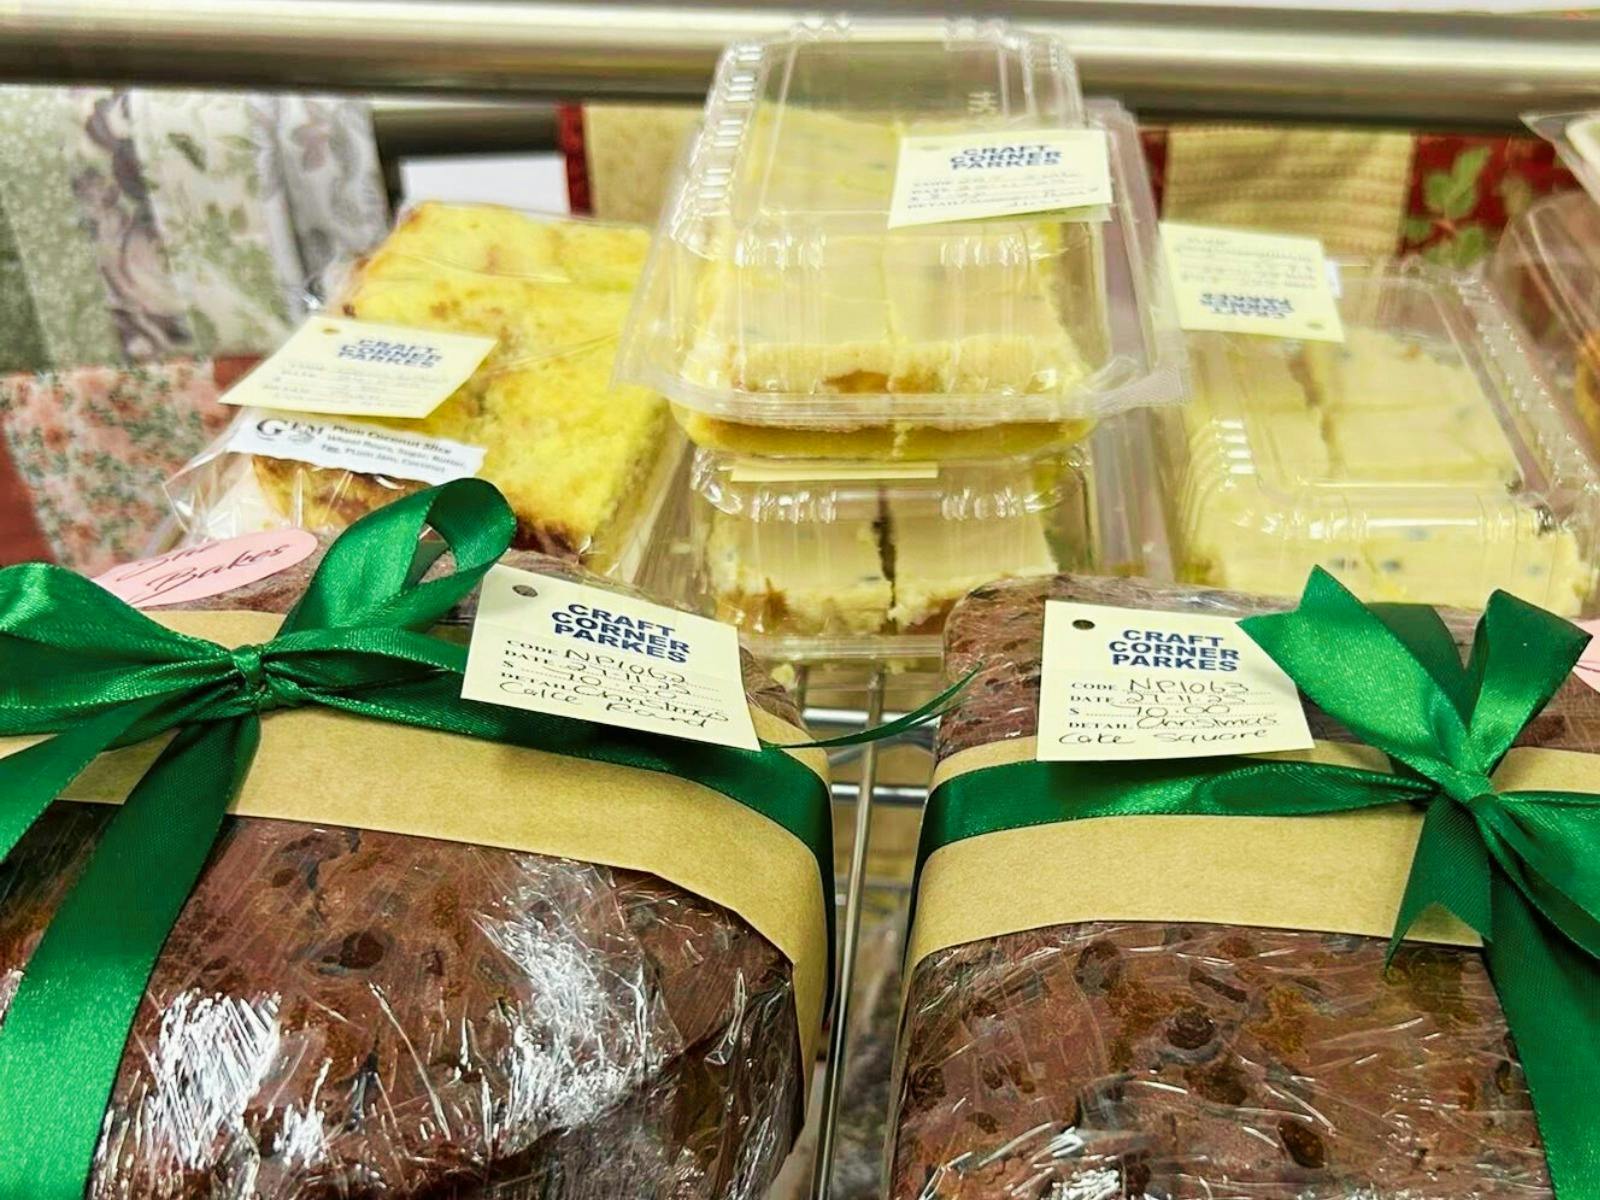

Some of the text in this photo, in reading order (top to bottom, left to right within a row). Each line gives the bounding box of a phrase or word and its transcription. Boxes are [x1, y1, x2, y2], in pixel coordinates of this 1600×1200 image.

[950, 151, 1062, 164] CORNER
[963, 143, 1051, 156] CRAFT
[952, 159, 1060, 170] PARKES
[341, 345, 443, 362] CORNER
[358, 338, 442, 353] CRAFT
[338, 351, 437, 368] PARKES
[568, 603, 676, 637] CRAFT
[551, 611, 691, 654] CORNER
[1122, 629, 1223, 648] CRAFT
[507, 639, 557, 656] CODE
[554, 623, 688, 664] PARKES
[1108, 641, 1240, 661] CORNER
[504, 649, 553, 665] DATE
[1112, 653, 1238, 672] PARKES
[1071, 682, 1118, 691] CODE
[1070, 695, 1113, 704] DATE
[1058, 731, 1136, 745] Cake
